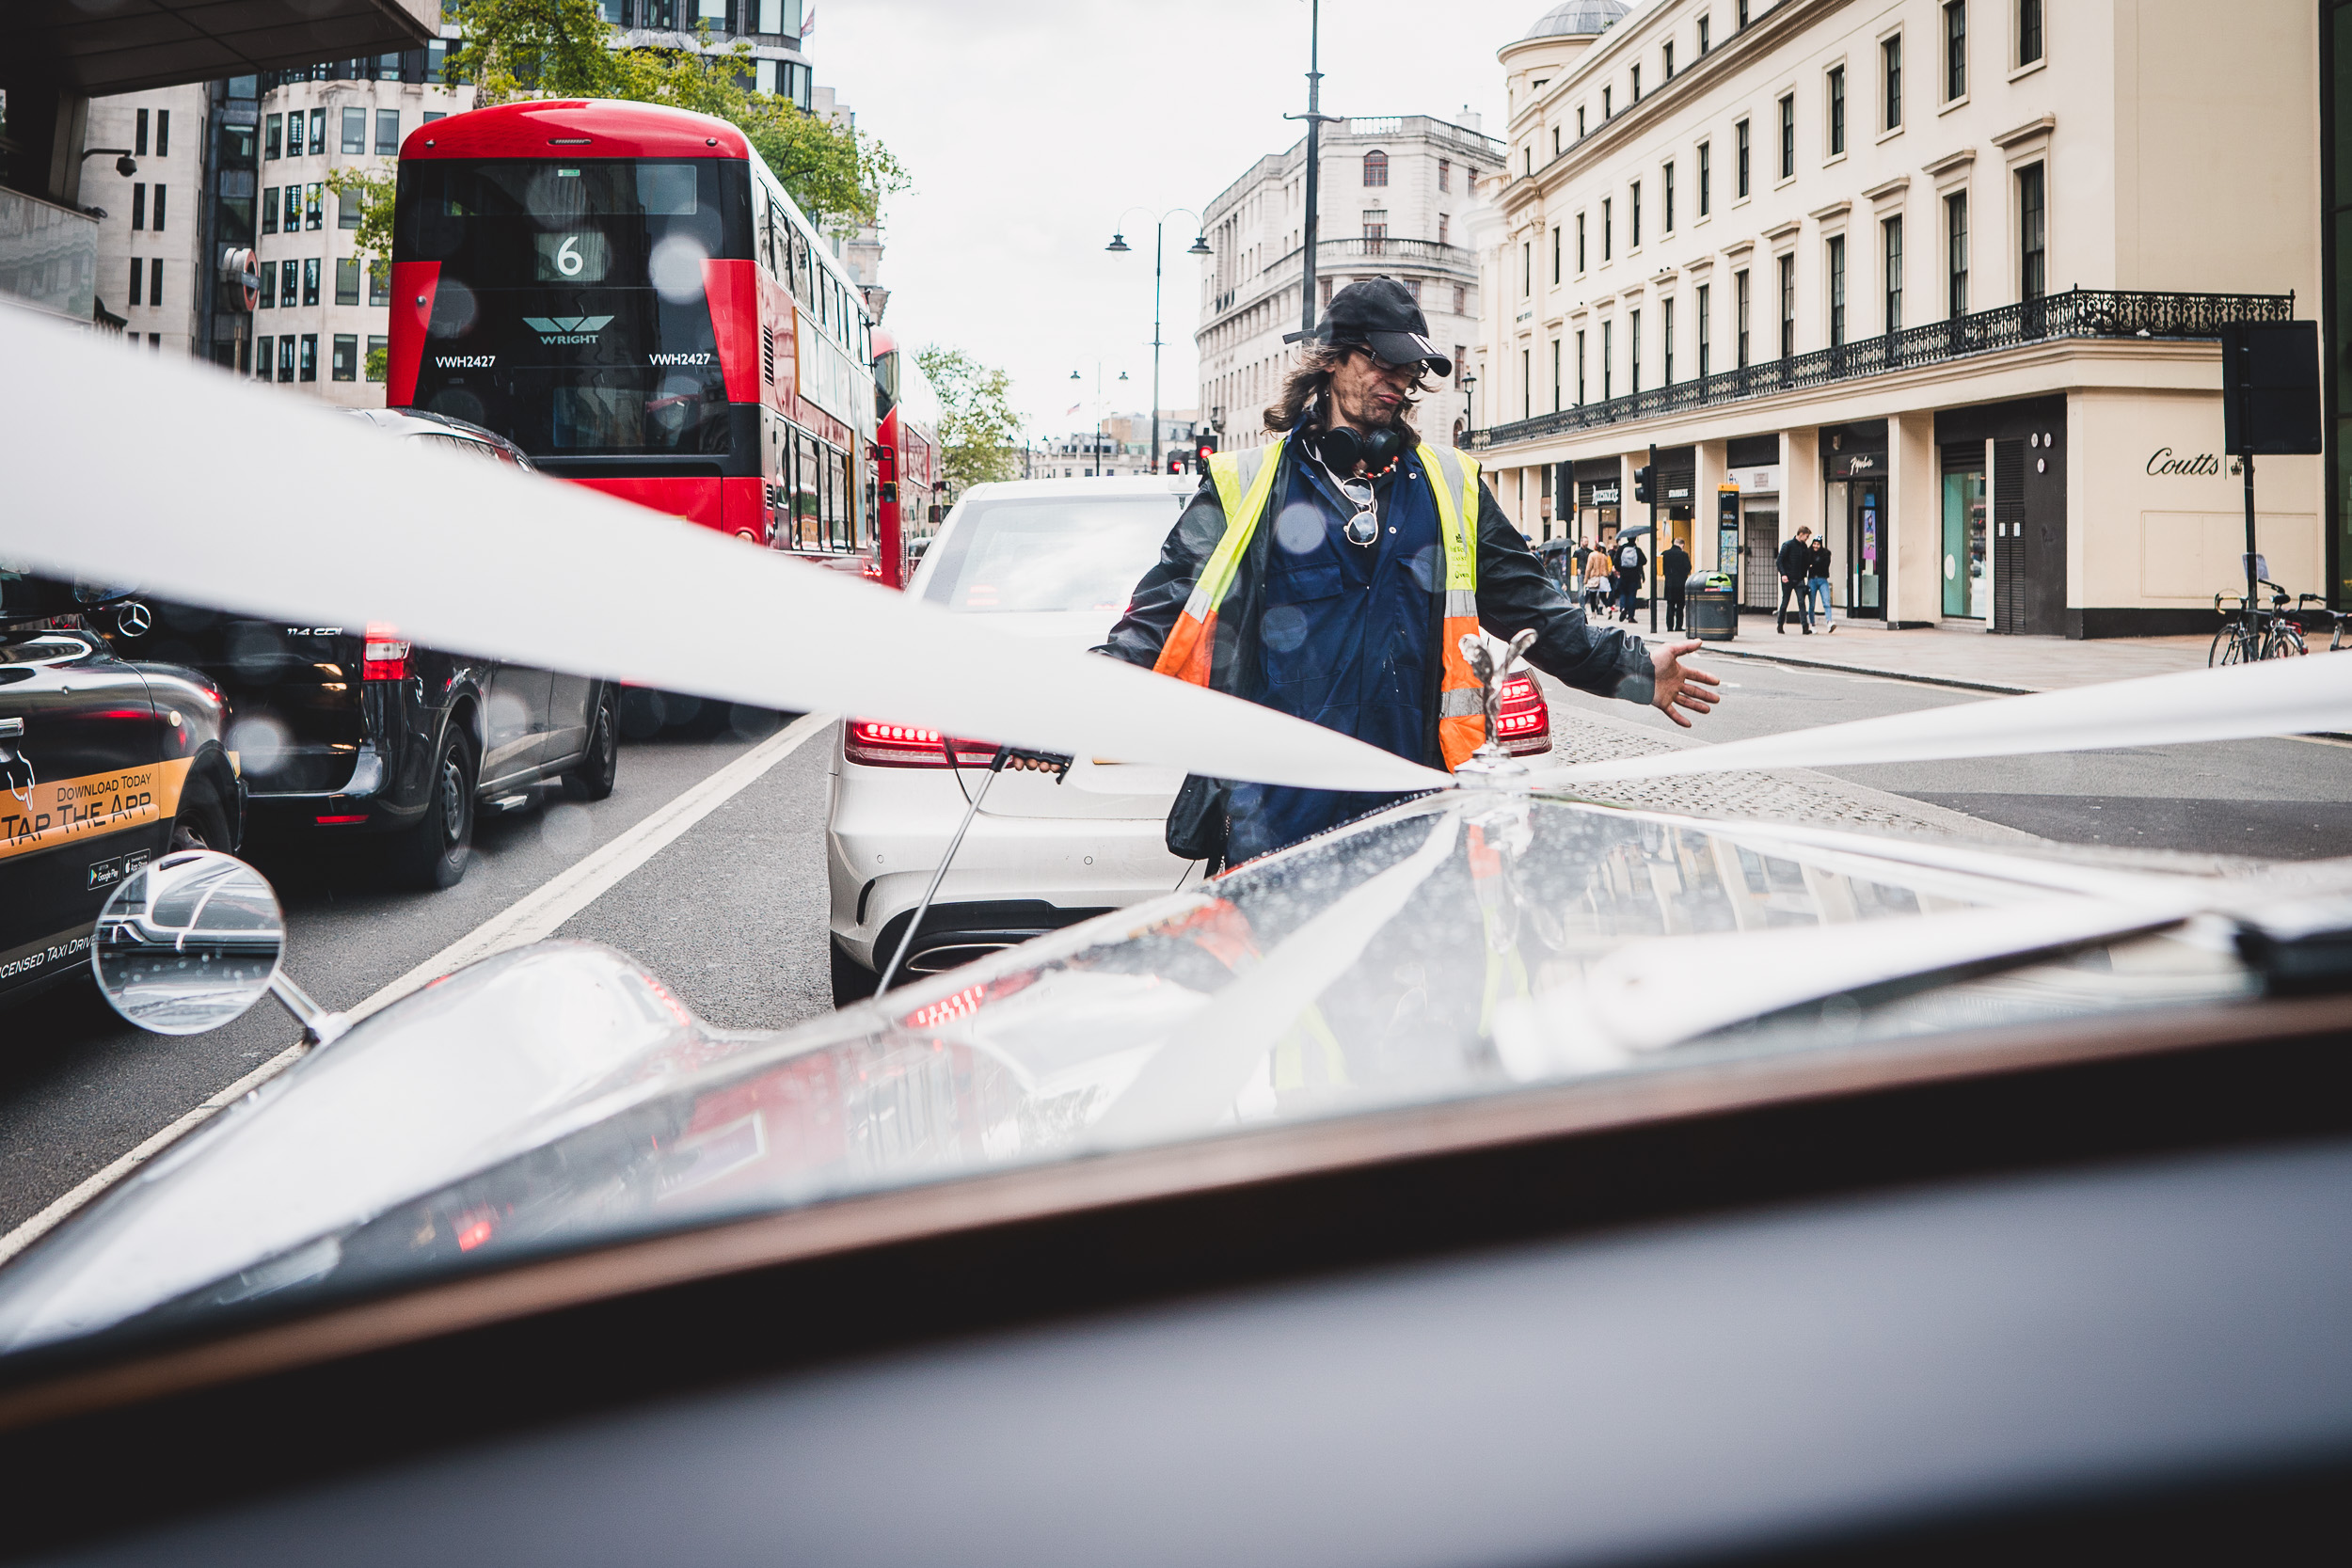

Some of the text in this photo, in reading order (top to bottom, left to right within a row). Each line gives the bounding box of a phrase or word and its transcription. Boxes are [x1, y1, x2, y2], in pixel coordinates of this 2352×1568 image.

[557, 236, 583, 276] 6
[539, 335, 598, 344] WRIGHT
[436, 356, 496, 368] VWH2427
[649, 353, 710, 366] VWH2427
[2146, 447, 2218, 476] Coutts
[313, 627, 343, 636] CDI
[57, 773, 151, 802] DOWNLOAD TODAY
[2, 792, 151, 847] TAP THE APP
[98, 870, 111, 882] Google
[47, 944, 68, 961] TAXI
